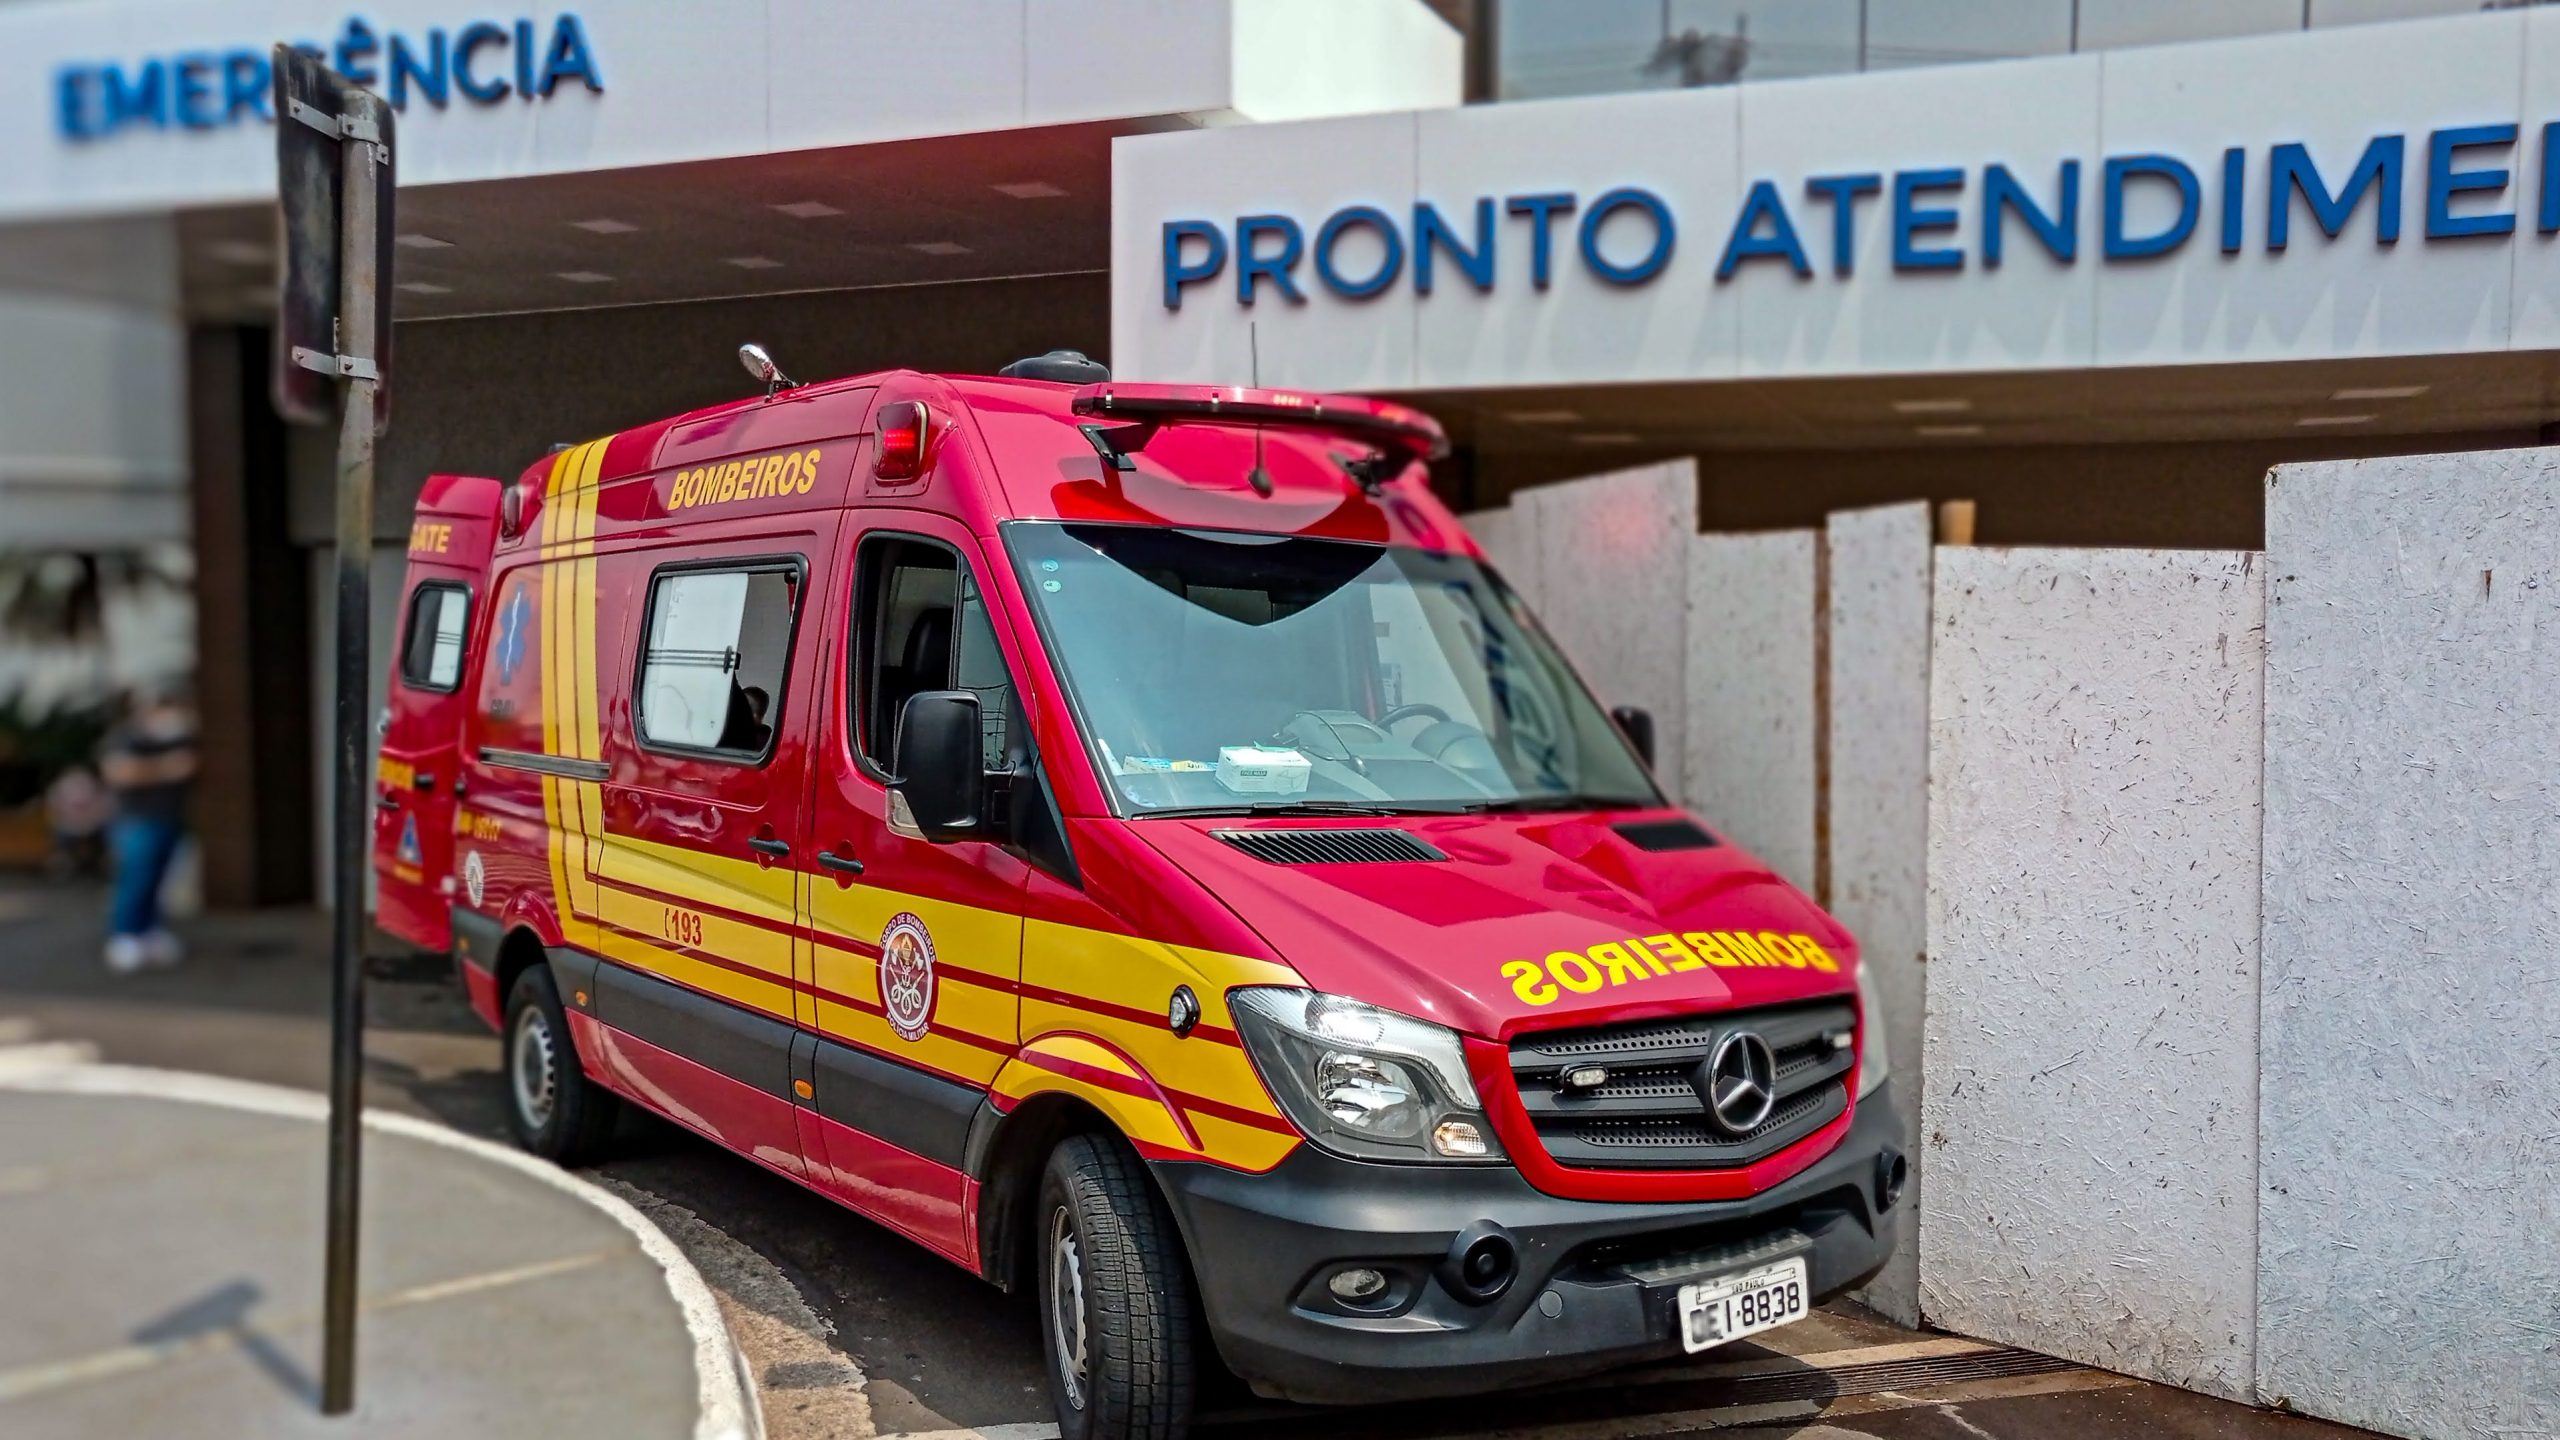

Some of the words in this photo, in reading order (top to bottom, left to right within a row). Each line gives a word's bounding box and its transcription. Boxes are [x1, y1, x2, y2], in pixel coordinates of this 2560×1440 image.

[55, 13, 605, 142] EMERÊNCIA
[1162, 188, 1677, 312] PRONTO
[1714, 121, 2560, 284] ATENDIME
[667, 448, 822, 511] BOMBEIROS
[671, 909, 702, 947] 193
[896, 913, 906, 925] DE
[906, 914, 937, 964] BOMBEIROS
